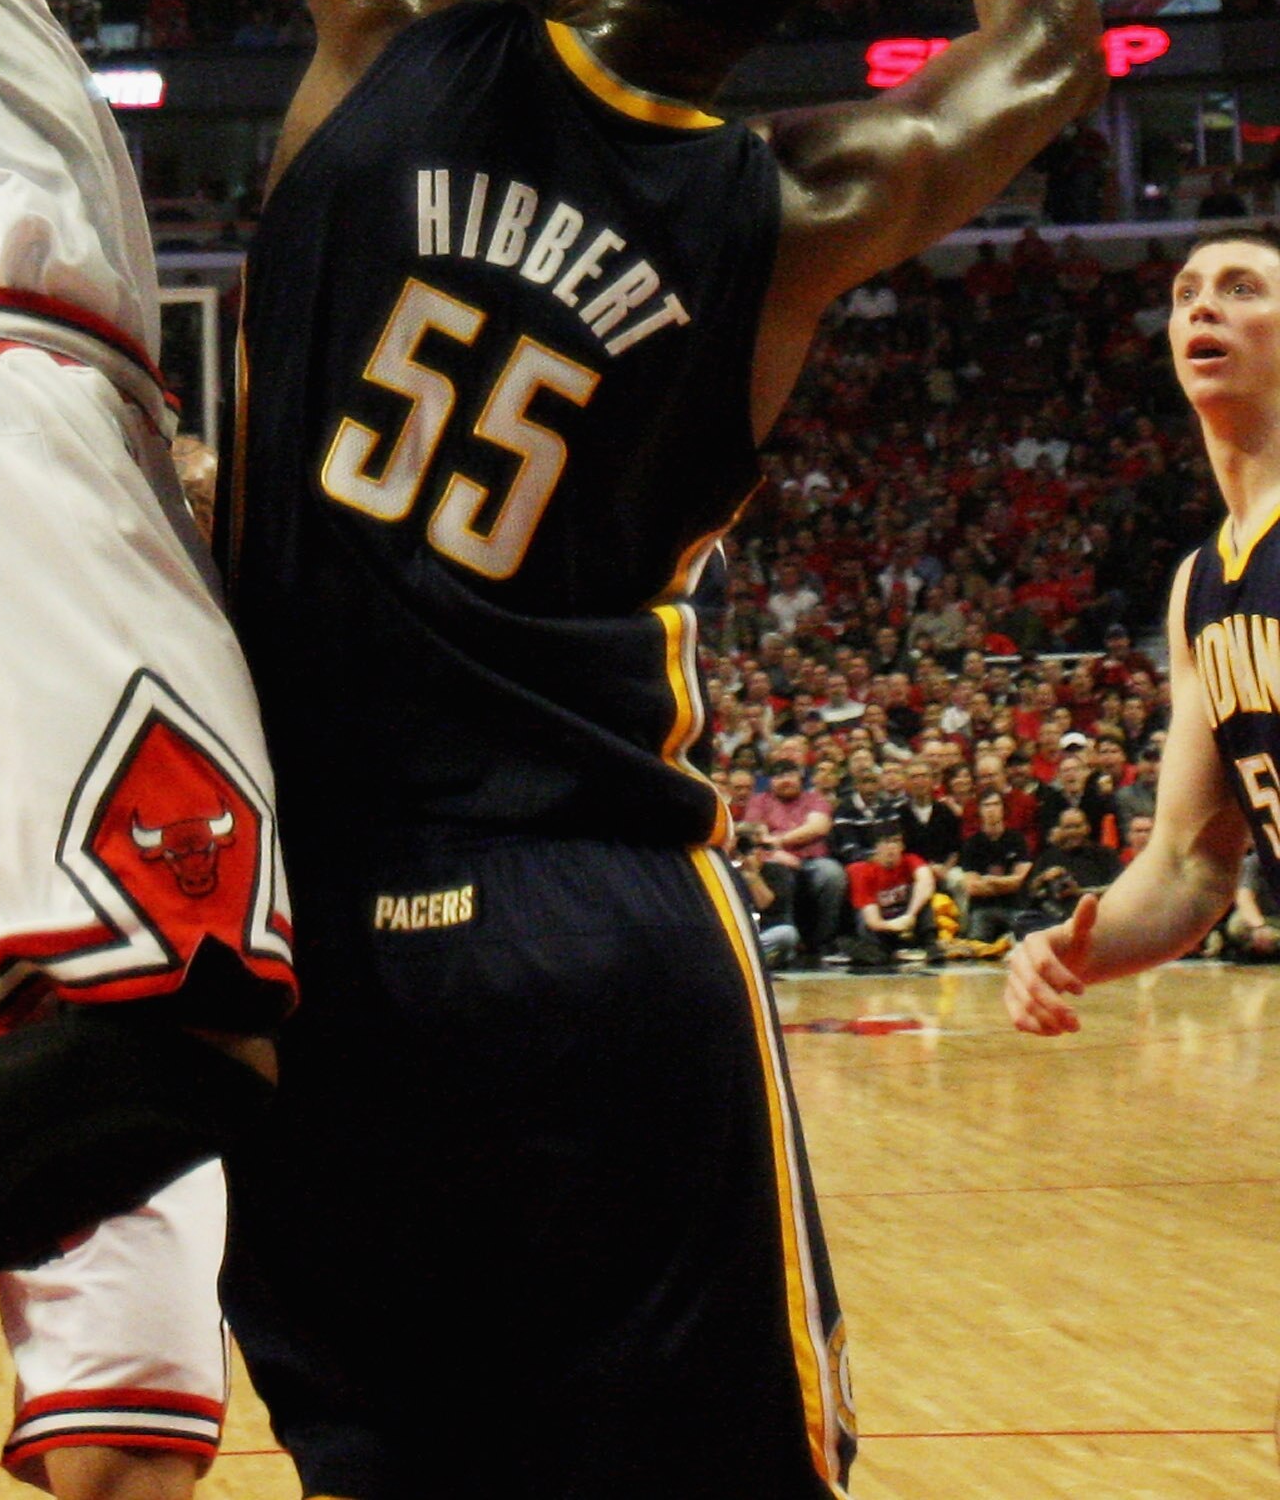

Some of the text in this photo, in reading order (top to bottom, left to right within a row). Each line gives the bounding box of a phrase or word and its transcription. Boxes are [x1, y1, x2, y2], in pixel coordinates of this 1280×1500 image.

[418, 169, 691, 357] HIBBERT
[321, 277, 602, 580] 55
[374, 884, 473, 930] PACERS
